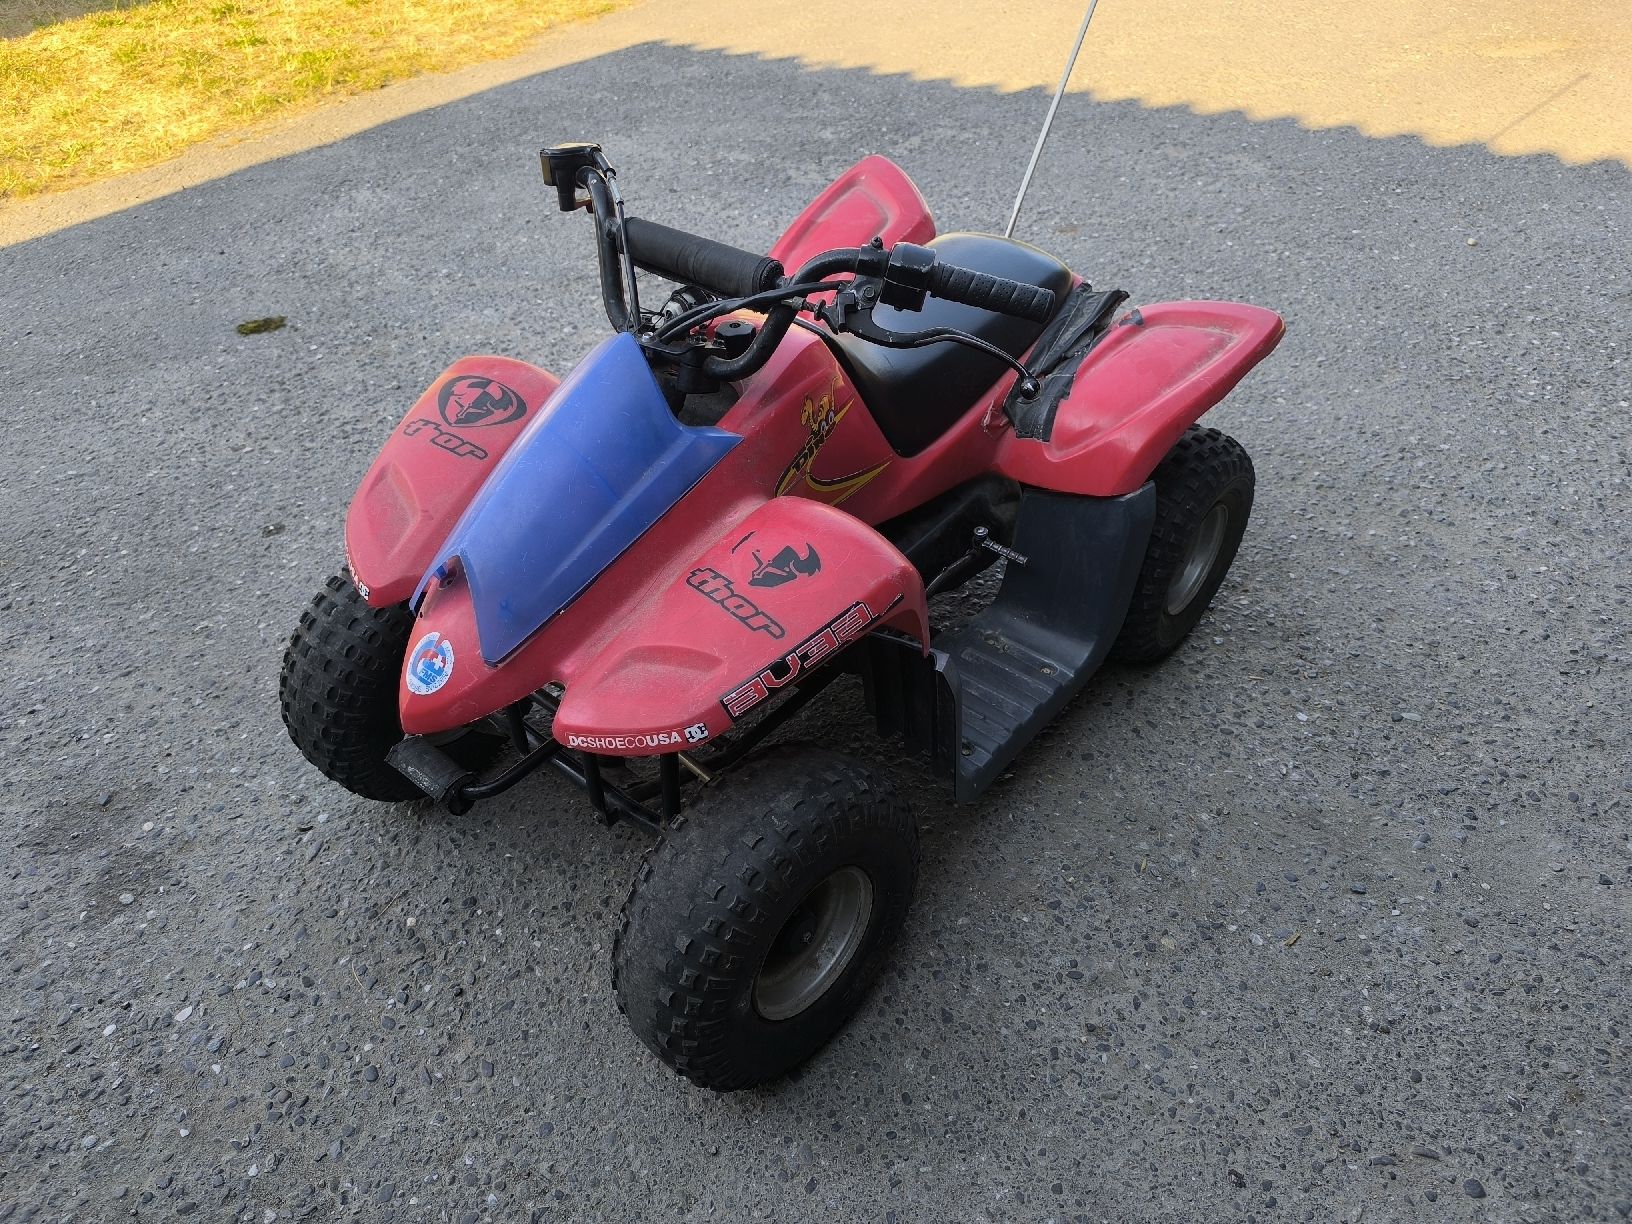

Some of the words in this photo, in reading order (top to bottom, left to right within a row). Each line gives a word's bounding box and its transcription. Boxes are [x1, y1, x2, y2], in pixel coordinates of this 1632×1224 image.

[685, 567, 786, 640] thor
[420, 667, 438, 683] FMS
[568, 731, 683, 749] DCSHOECOUSA
